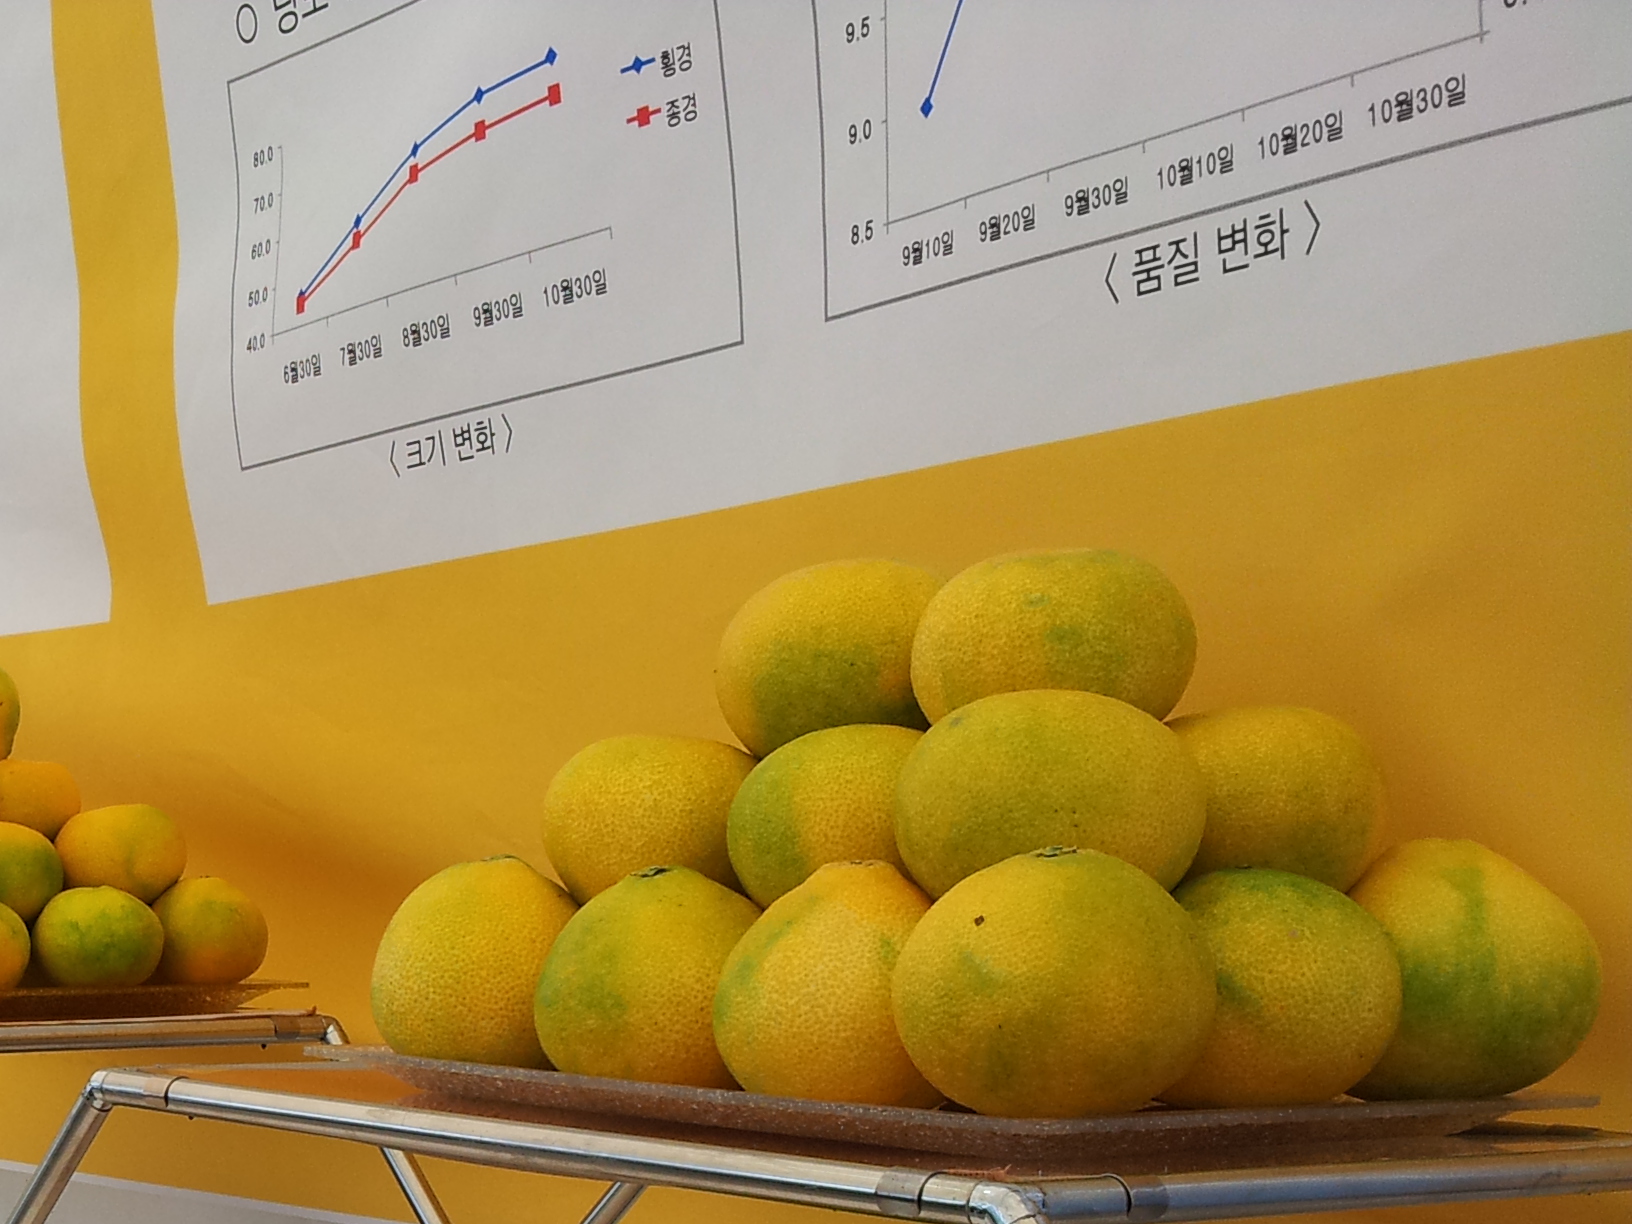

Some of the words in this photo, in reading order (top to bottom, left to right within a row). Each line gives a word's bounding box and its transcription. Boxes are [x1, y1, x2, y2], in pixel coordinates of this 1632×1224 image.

[845, 15, 871, 44] 9.5
[659, 42, 694, 80] 횡경
[665, 92, 699, 129] 종경
[848, 118, 872, 145] 9.0
[253, 146, 274, 169] 80.0
[902, 230, 955, 267] 9월10일
[979, 203, 1036, 243] 9월20일
[1064, 176, 1130, 217] 9월30일
[1156, 143, 1235, 190] 10월10일
[1257, 109, 1345, 161] 10월20일
[1367, 73, 1468, 128] 10월30일
[253, 192, 274, 215] 70.0
[851, 219, 874, 246] 8.5
[251, 237, 272, 260] 60.0
[248, 286, 269, 308] 50.0
[283, 353, 322, 386] 6월30일
[340, 333, 384, 368] 7월30일
[402, 313, 451, 348] 8월30일
[473, 292, 524, 328] 9월30일
[542, 267, 609, 309] 10월30일
[246, 333, 266, 355] 40.0
